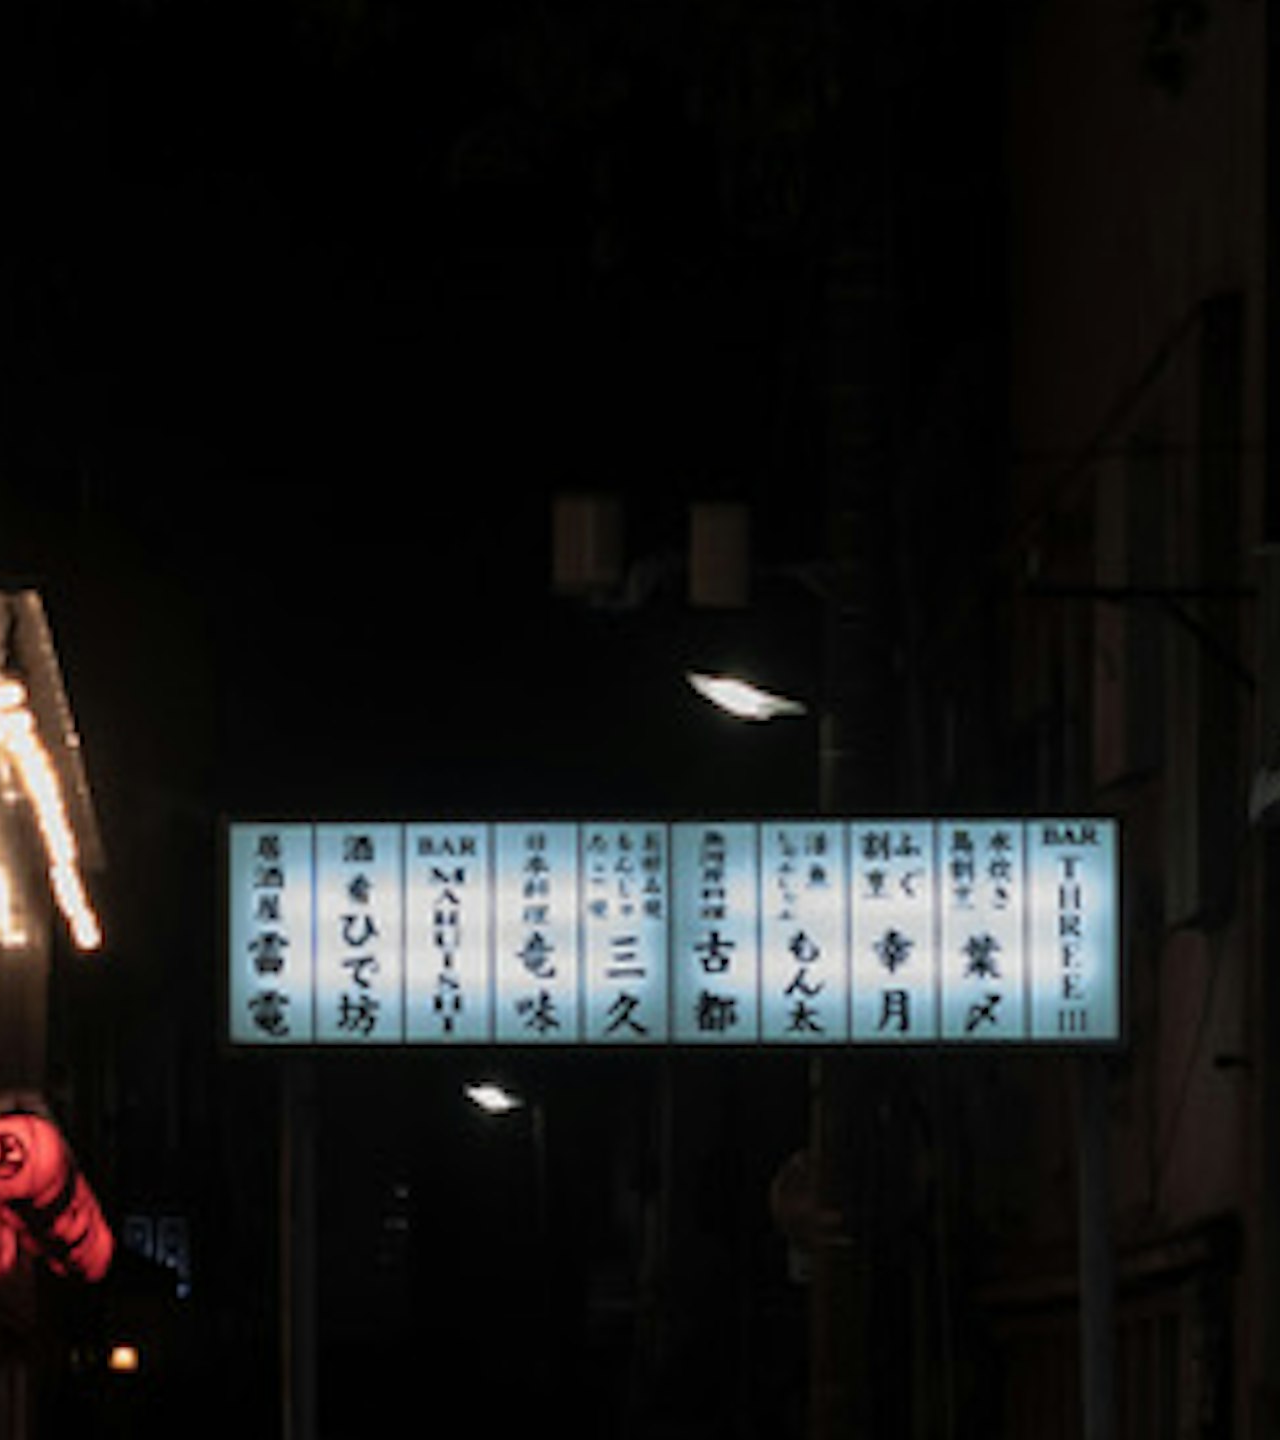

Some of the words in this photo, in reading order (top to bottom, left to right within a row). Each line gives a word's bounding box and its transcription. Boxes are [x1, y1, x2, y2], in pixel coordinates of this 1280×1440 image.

[253, 835, 286, 921] 居酒屋
[417, 837, 477, 857] BAR
[522, 832, 551, 924] 日本料理
[1041, 827, 1100, 846] BAR
[337, 913, 381, 1037] ひで坊
[1056, 857, 1083, 1001] THREE
[604, 935, 648, 1036] 三久
[692, 930, 740, 1032] 古都
[783, 930, 824, 1034] もん太
[871, 927, 914, 1033] 幸月
